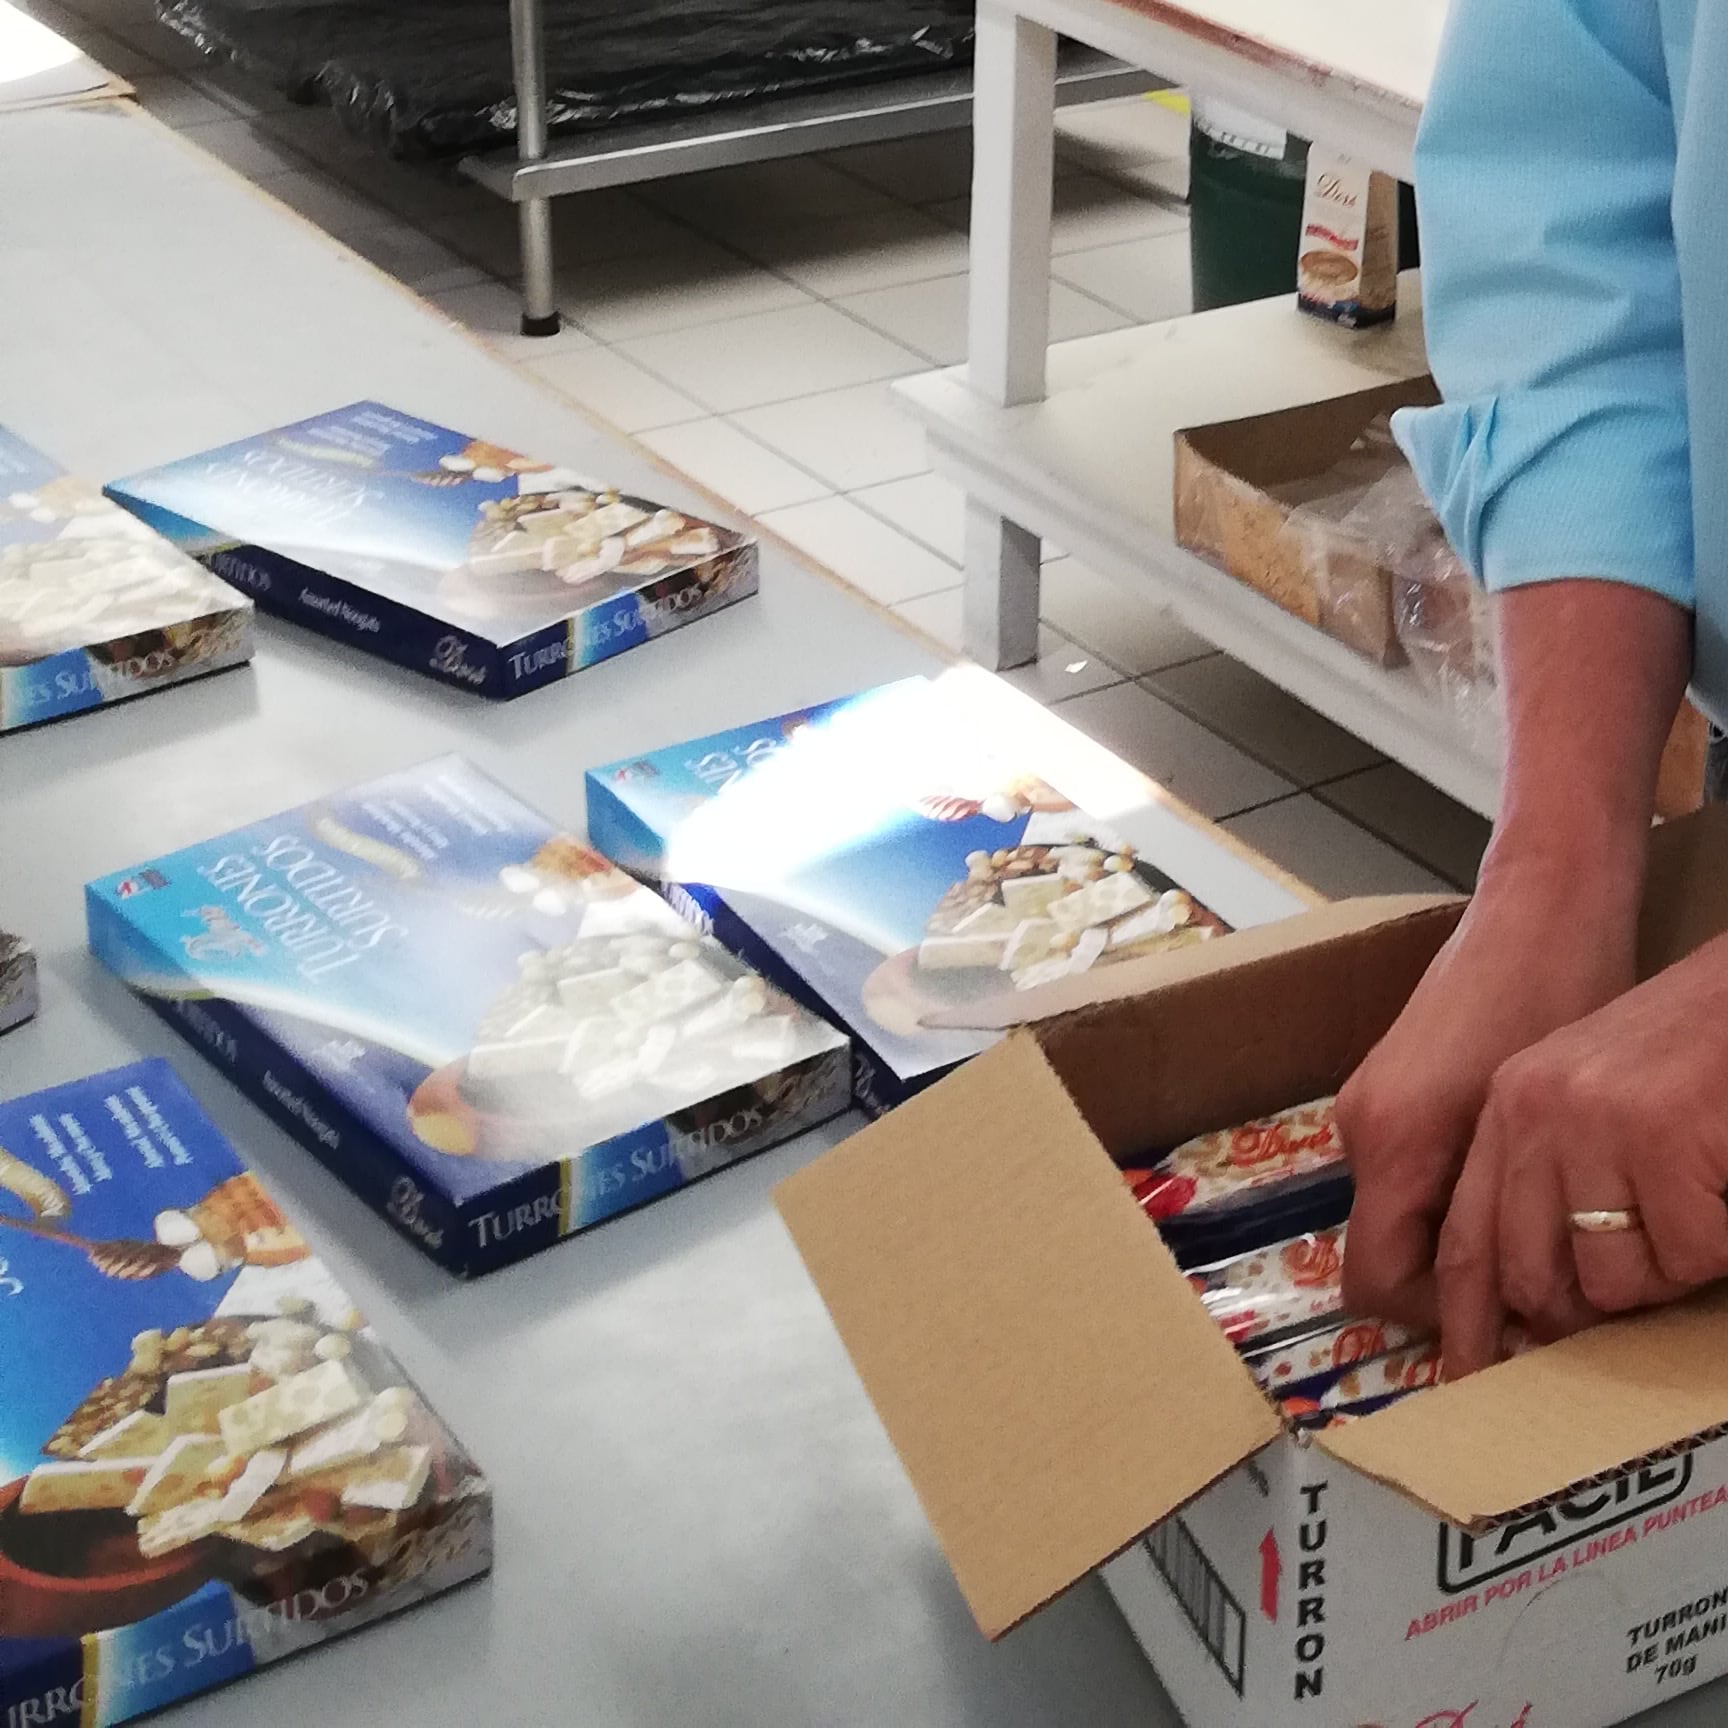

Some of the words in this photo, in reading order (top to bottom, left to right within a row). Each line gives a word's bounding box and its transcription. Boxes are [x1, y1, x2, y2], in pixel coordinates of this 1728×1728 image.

[197, 854, 360, 984] TURRONES
[252, 834, 409, 948] SURTIDOS
[1294, 1481, 1329, 1700] TURRON
[1404, 1595, 1479, 1642] ABRIR
[1485, 1570, 1532, 1607] POR
[1539, 1556, 1568, 1584] LA
[1572, 1525, 1637, 1569] LINEA
[1625, 1585, 1728, 1648] TURRON
[1626, 1643, 1660, 1674] DE
[1654, 1654, 1699, 1684] 70g
